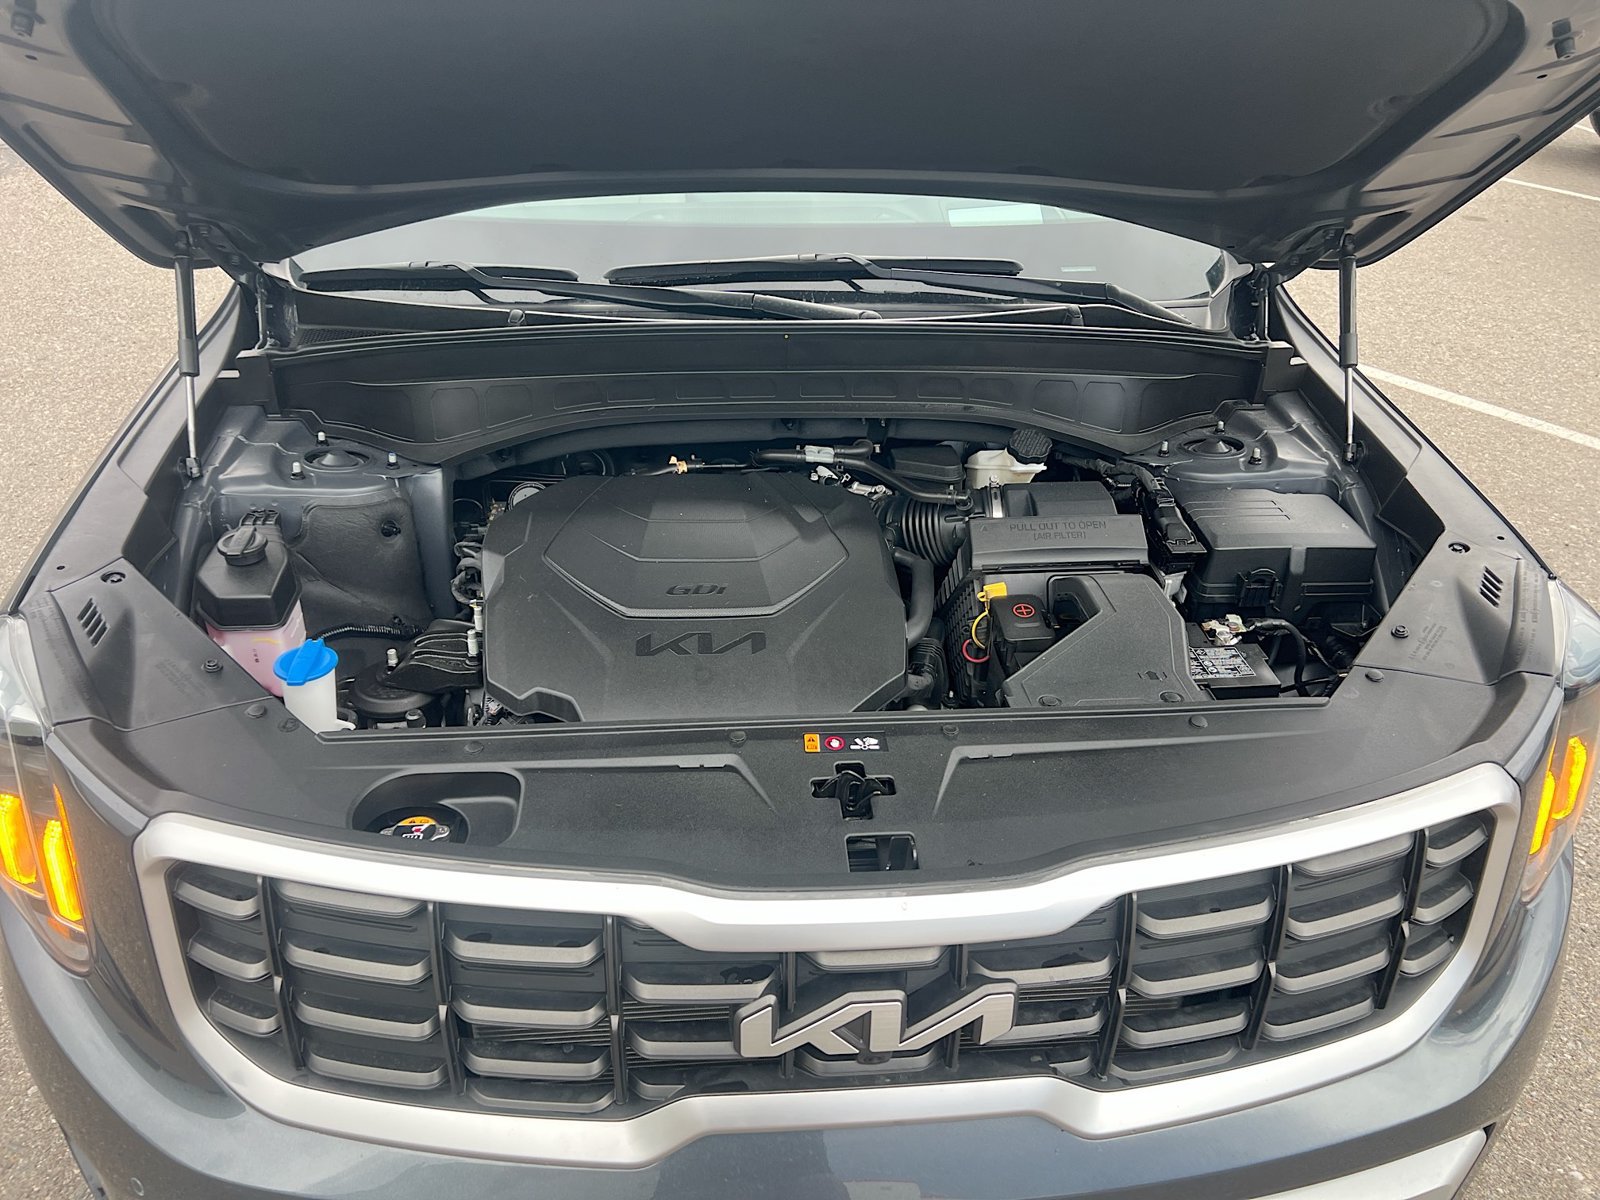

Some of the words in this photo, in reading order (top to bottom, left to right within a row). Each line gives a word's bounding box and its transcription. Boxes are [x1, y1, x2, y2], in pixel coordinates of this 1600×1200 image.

[1009, 522, 1037, 532] PULL
[1038, 521, 1060, 531] OUT
[1063, 521, 1077, 530] TO
[1078, 520, 1107, 530] OPEN
[635, 631, 767, 657] KIA
[738, 987, 1017, 1058] KIA
